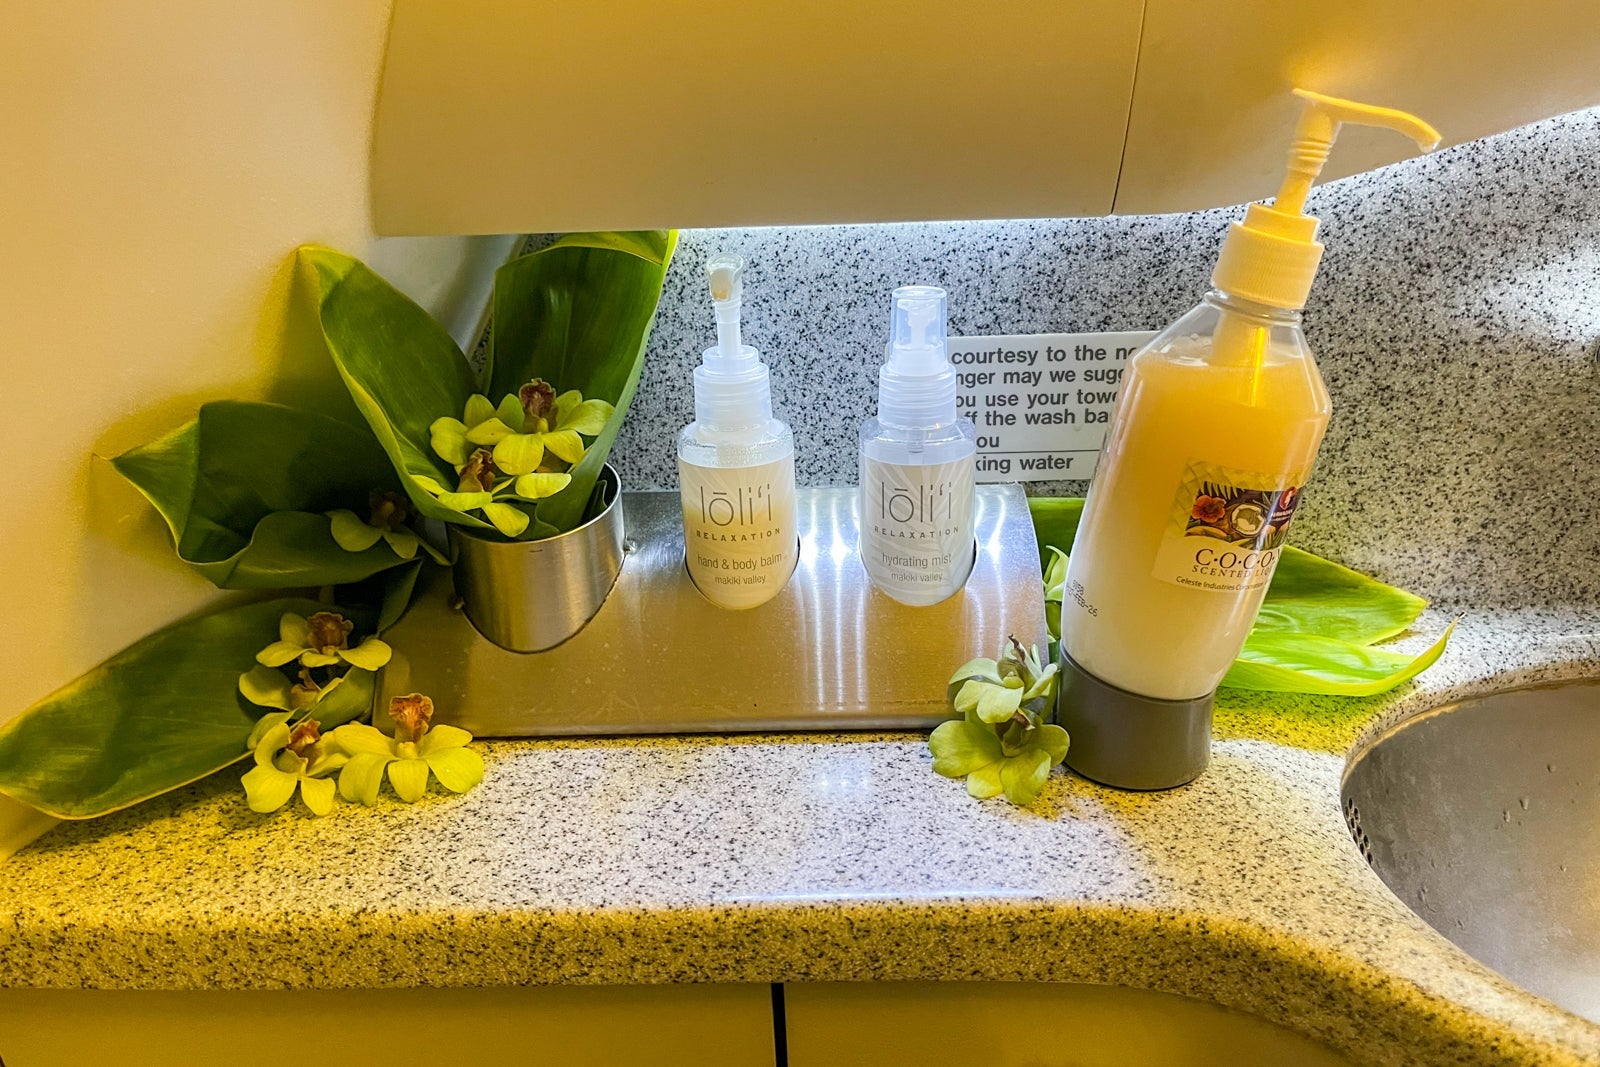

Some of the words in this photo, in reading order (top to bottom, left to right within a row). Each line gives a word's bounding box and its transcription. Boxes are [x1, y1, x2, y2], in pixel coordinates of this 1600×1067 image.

[951, 348, 1038, 366] courtesy
[1046, 346, 1066, 362] to
[1074, 345, 1107, 361] the
[1003, 371, 1042, 387] may
[1050, 369, 1076, 383] we
[985, 394, 1018, 407] use
[1027, 391, 1069, 409] your
[985, 410, 1016, 426] the
[1024, 408, 1075, 425] wash
[1019, 455, 1074, 471] water
[696, 528, 780, 542] RELAXATION
[874, 525, 959, 539] RELAXATION
[697, 554, 719, 569] hand
[721, 559, 730, 570] &
[732, 558, 758, 571] body
[760, 553, 782, 567] balm
[882, 552, 928, 569] hydrating
[931, 553, 952, 565] mist
[891, 573, 917, 582] makiki
[920, 573, 943, 582] valley
[1191, 564, 1250, 578] SCENTED
[715, 575, 740, 585] makiki
[742, 575, 766, 585] valley
[1175, 575, 1202, 587] Celeste
[1203, 581, 1235, 591] Industries
